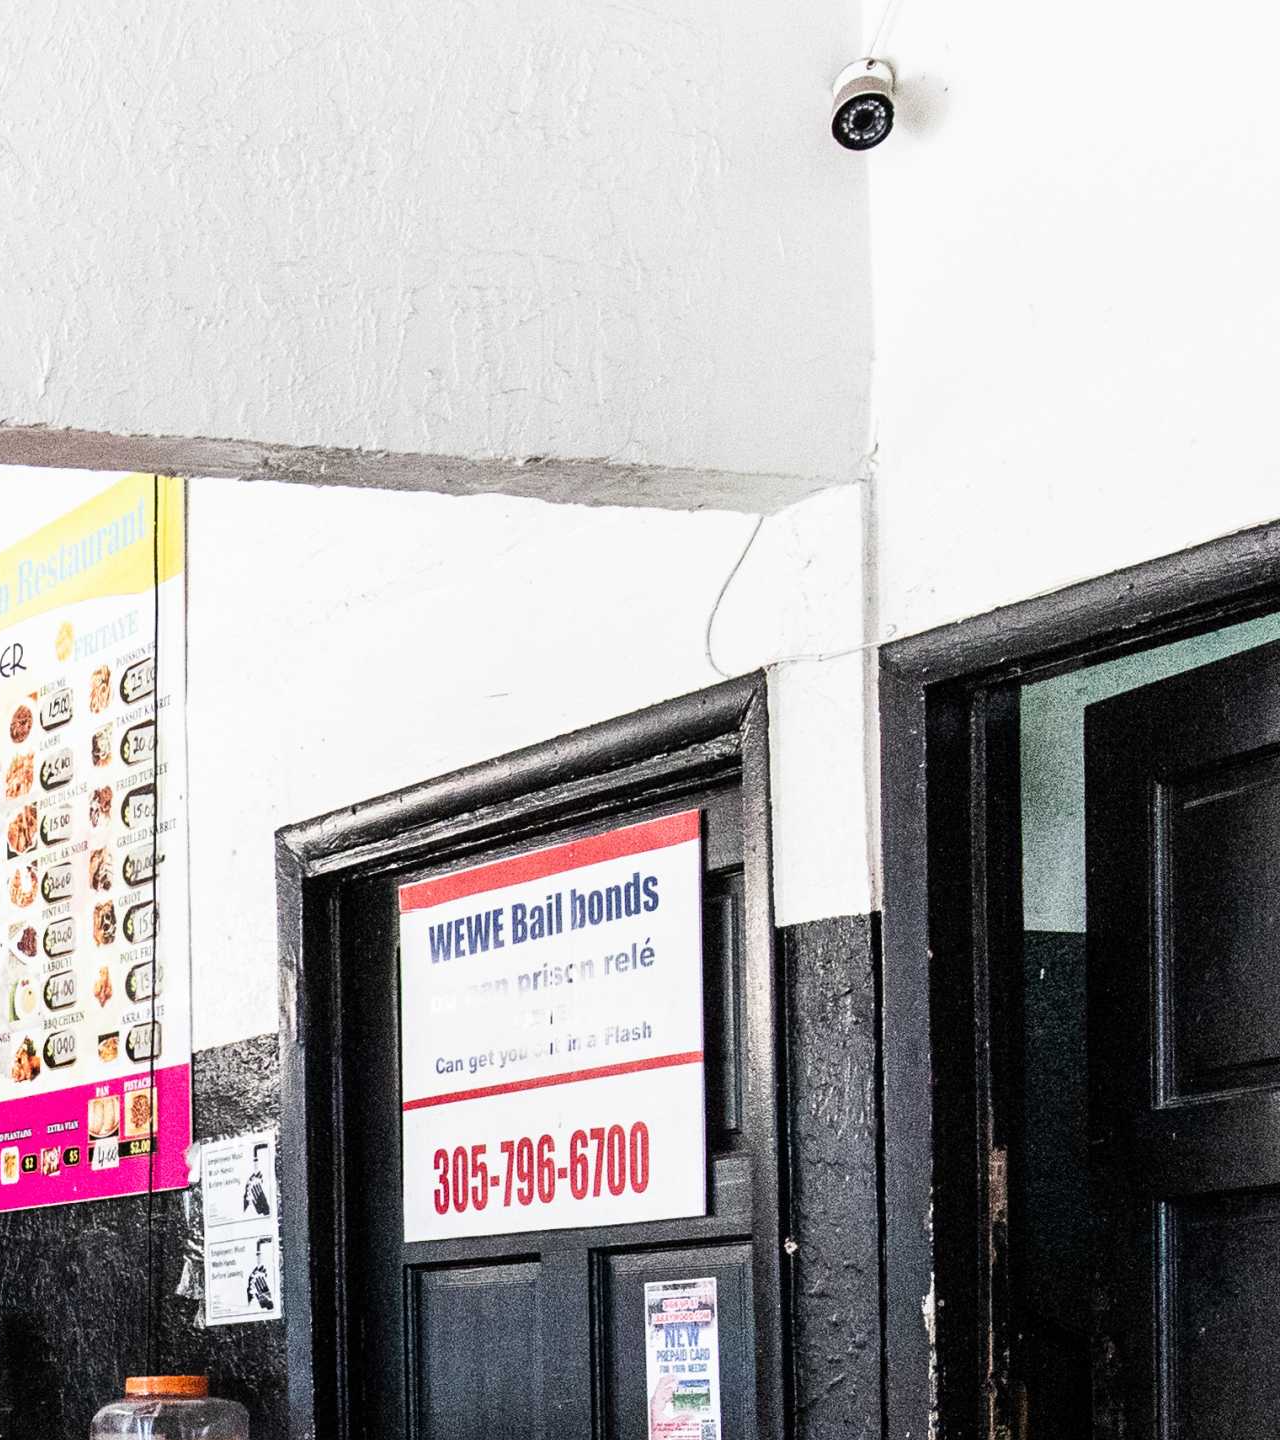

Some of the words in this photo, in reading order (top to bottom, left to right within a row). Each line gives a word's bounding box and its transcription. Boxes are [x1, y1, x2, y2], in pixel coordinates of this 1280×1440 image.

[16, 495, 146, 605] Restaurant
[144, 694, 172, 716] KARIT
[429, 907, 504, 964] WEWE
[511, 892, 563, 945] Bail
[570, 872, 660, 931] bonds
[517, 958, 595, 994] prison
[604, 937, 656, 976] relé
[435, 1056, 464, 1075] Can
[468, 1051, 495, 1075] get
[498, 1047, 528, 1069] you
[604, 1021, 653, 1047] Flash
[433, 1120, 650, 1216] 305-796-6700
[656, 1349, 687, 1362] PREPAID
[689, 1347, 710, 1361] CARD
[665, 1323, 700, 1348] NEW
